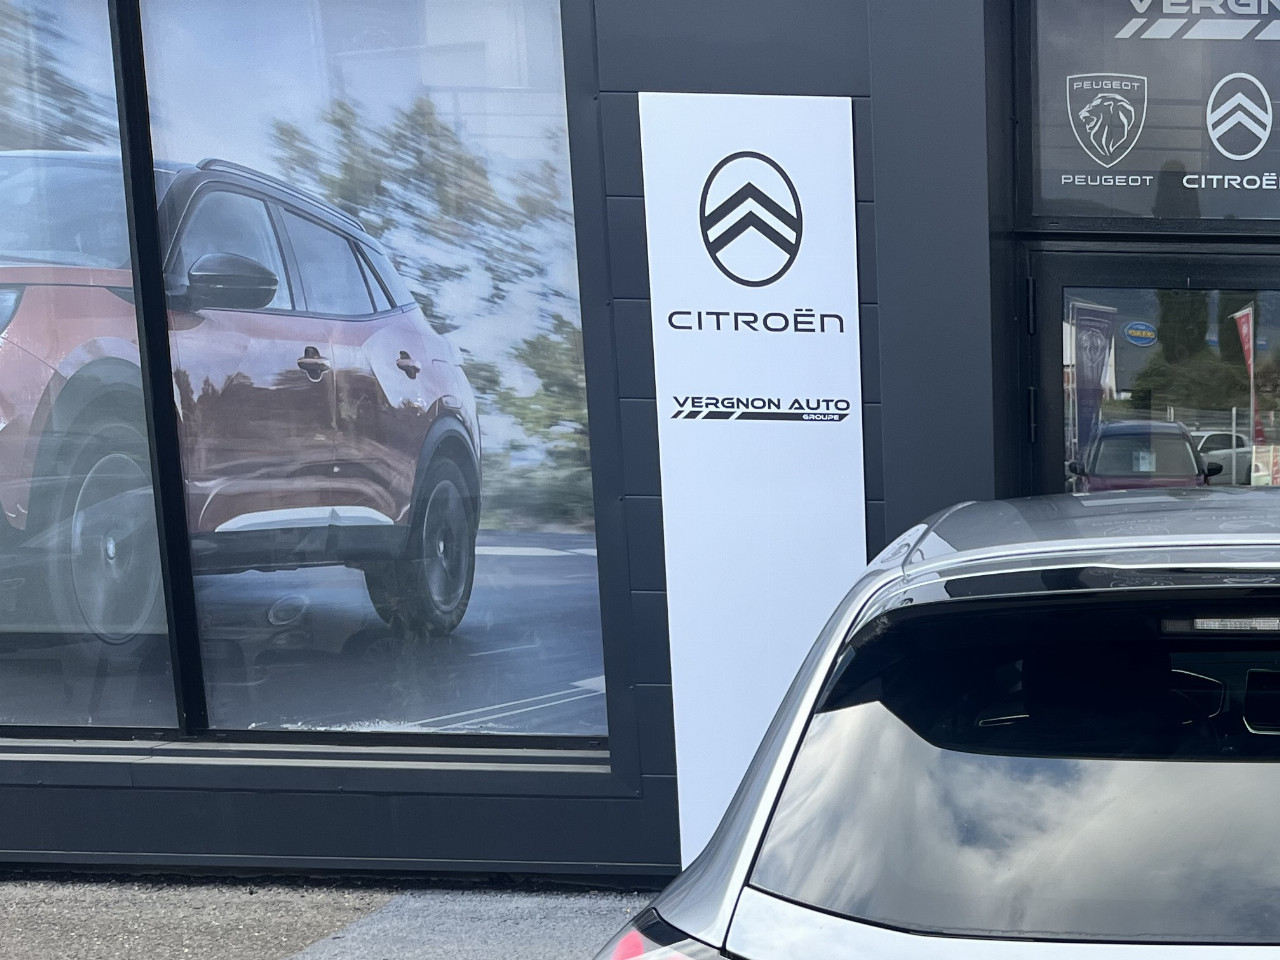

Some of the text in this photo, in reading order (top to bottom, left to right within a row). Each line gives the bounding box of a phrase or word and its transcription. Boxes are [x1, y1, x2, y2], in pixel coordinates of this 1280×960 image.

[1074, 81, 1140, 91] PEUGEOT
[1062, 175, 1154, 186] PEUGEOT
[673, 396, 850, 411] VERGNON AUTO
[802, 413, 840, 421] GROUPE
